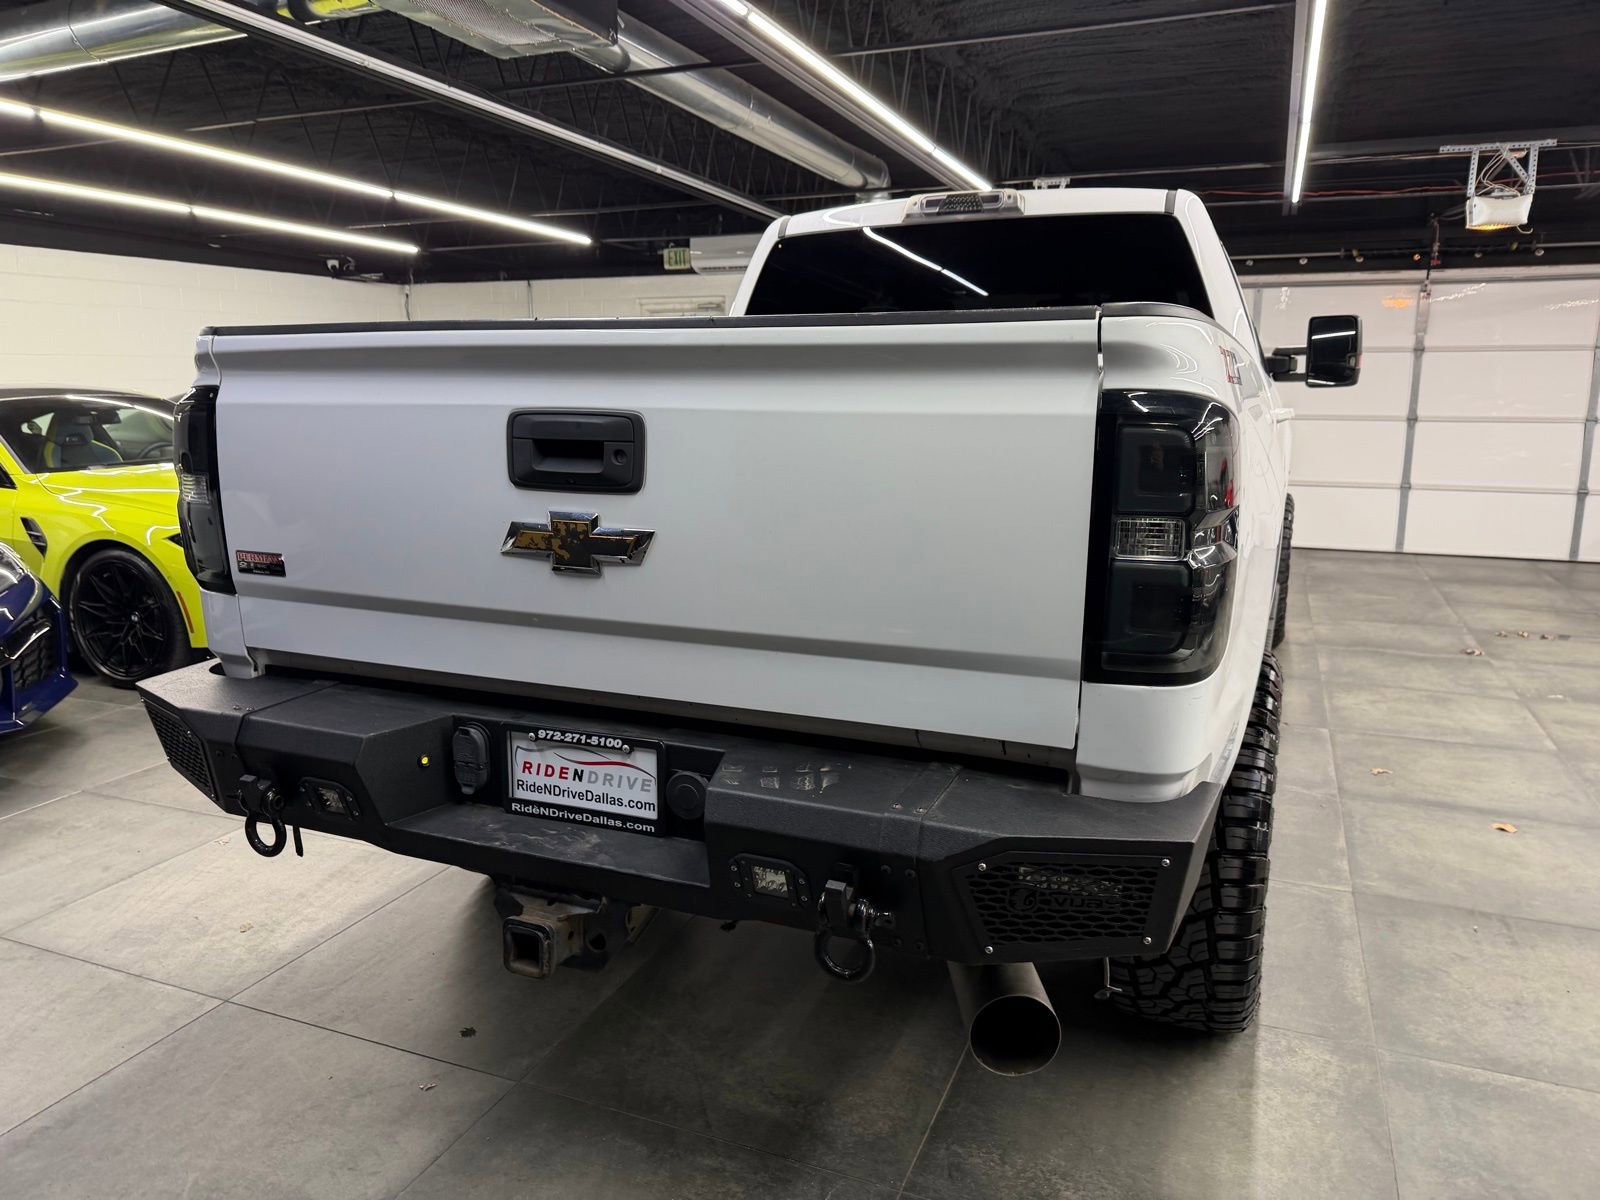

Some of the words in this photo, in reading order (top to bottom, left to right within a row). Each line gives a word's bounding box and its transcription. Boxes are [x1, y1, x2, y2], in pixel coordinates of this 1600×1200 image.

[667, 249, 687, 267] EXIT
[537, 729, 623, 749] 972-271-5100
[521, 760, 653, 793] RIDENDRIVE
[516, 778, 656, 812] RideNDriveDallas.com
[511, 802, 656, 833] RideNDriveDallas.com
